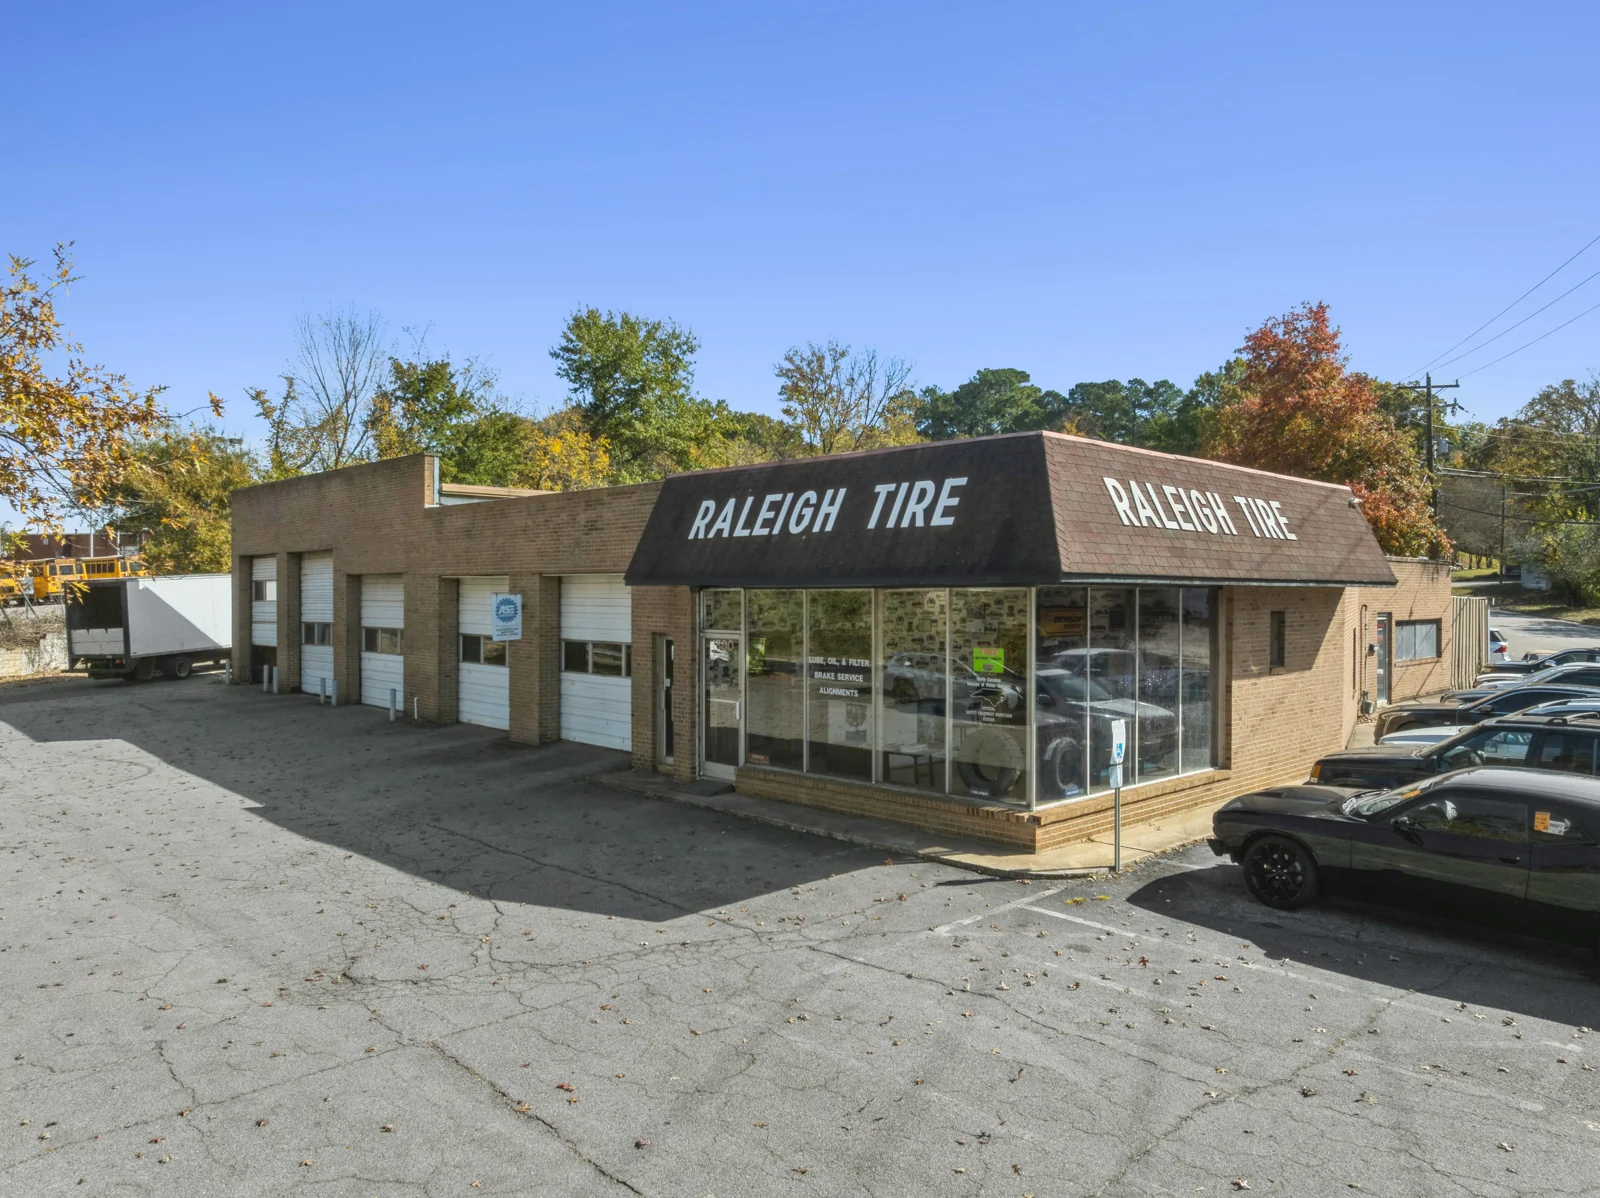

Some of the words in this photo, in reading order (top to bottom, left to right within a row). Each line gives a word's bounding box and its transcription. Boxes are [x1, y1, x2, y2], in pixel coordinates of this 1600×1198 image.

[688, 488, 847, 540] RALEIGH
[866, 477, 968, 530] TIRE
[1102, 477, 1237, 535] RALEIGH
[1233, 496, 1297, 541] TIRE
[499, 605, 515, 614] ASE
[809, 656, 826, 665] LUBE,
[828, 657, 839, 666] OIL,
[841, 658, 847, 666] &
[849, 659, 870, 667] FILTER
[814, 671, 835, 680] BRAKE
[837, 673, 864, 682] SERVICE
[819, 687, 859, 697] ALIGNMENTS
